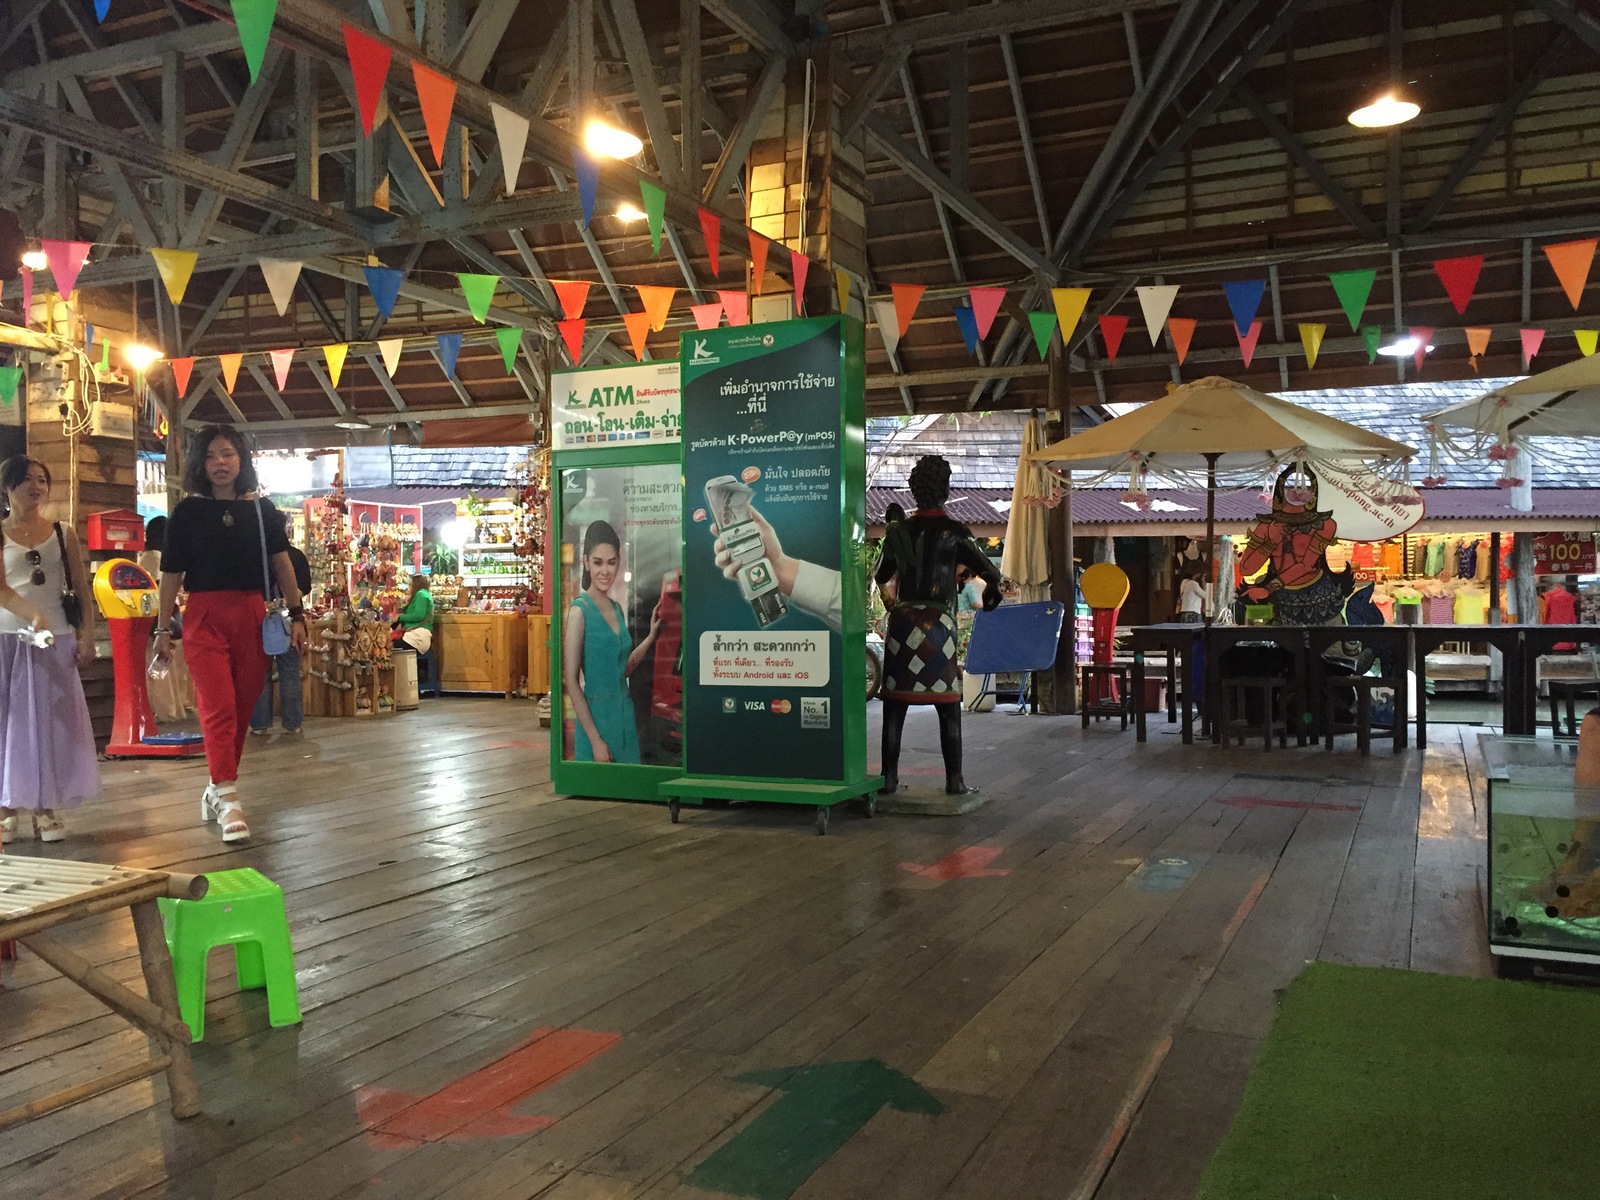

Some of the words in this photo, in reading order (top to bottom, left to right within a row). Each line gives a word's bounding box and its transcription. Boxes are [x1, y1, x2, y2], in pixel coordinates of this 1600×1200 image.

[720, 373, 835, 396] เพิ่มอำนาจการใช้จ่าย
[588, 385, 635, 408] ATM
[691, 437, 727, 451] รูดบัตรด้วย
[805, 431, 836, 442] (mPOS)
[765, 465, 788, 479] มั่นใจ
[791, 465, 831, 478] ปลอดภัย
[1550, 544, 1581, 560] 100
[1353, 571, 1368, 581] 00
[754, 639, 816, 652] สะดวกกว่า
[713, 656, 732, 667] ที่แรก
[765, 656, 794, 667] ที่รองรับ
[713, 667, 741, 679] ทั้งระบบ
[744, 671, 775, 679] Android
[795, 671, 809, 679] iOS
[744, 701, 766, 711] VISA
[804, 706, 818, 714] No.
[821, 701, 828, 714] 1
